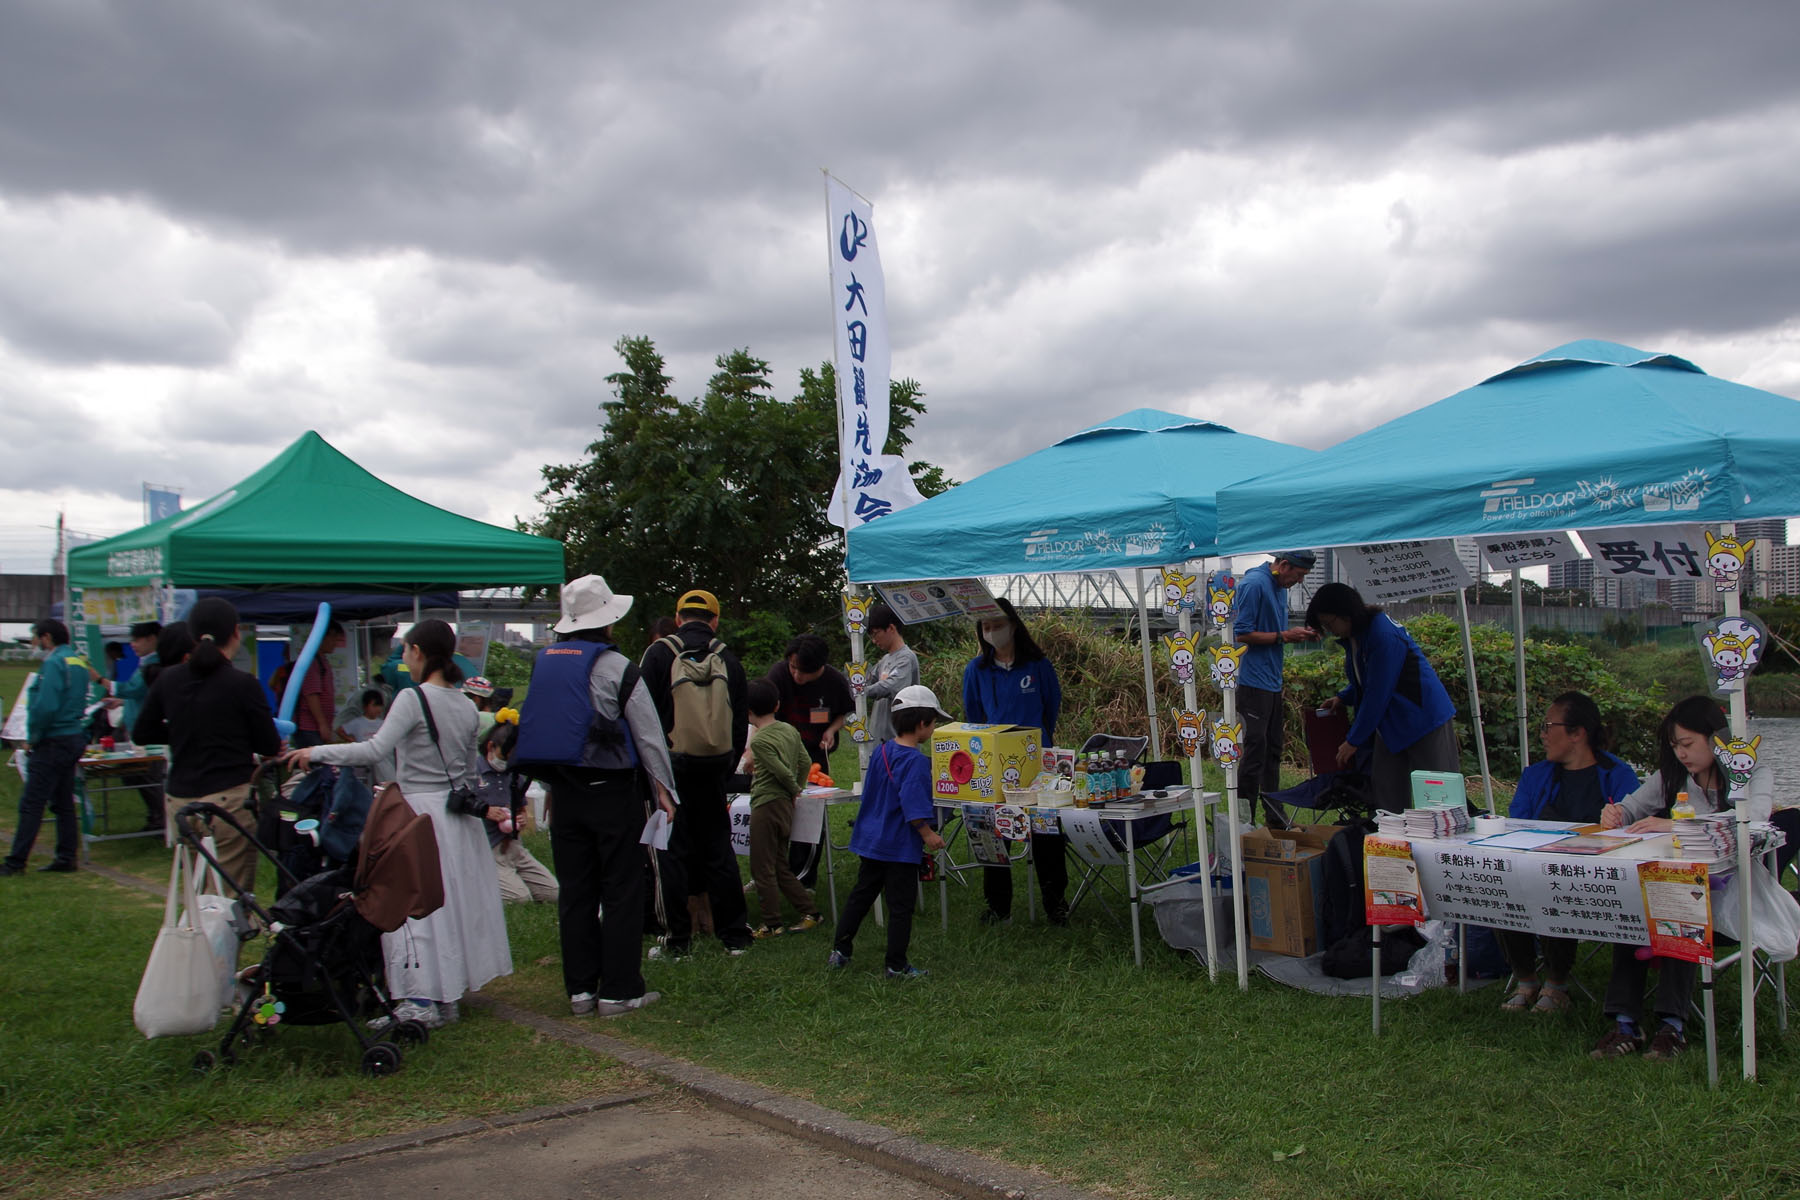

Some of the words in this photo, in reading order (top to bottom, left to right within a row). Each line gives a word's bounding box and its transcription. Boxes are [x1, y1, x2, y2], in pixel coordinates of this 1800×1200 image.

[1502, 491, 1576, 511] FIELDOOR
[1482, 511, 1515, 521] Powered
[1517, 511, 1528, 520] by
[1486, 536, 1562, 554] 乗船券購入
[1505, 550, 1556, 564] はこちら
[1596, 540, 1703, 577] 受付
[1445, 883, 1509, 898] 小学生:300円
[1553, 895, 1622, 909] 小学生:300円
